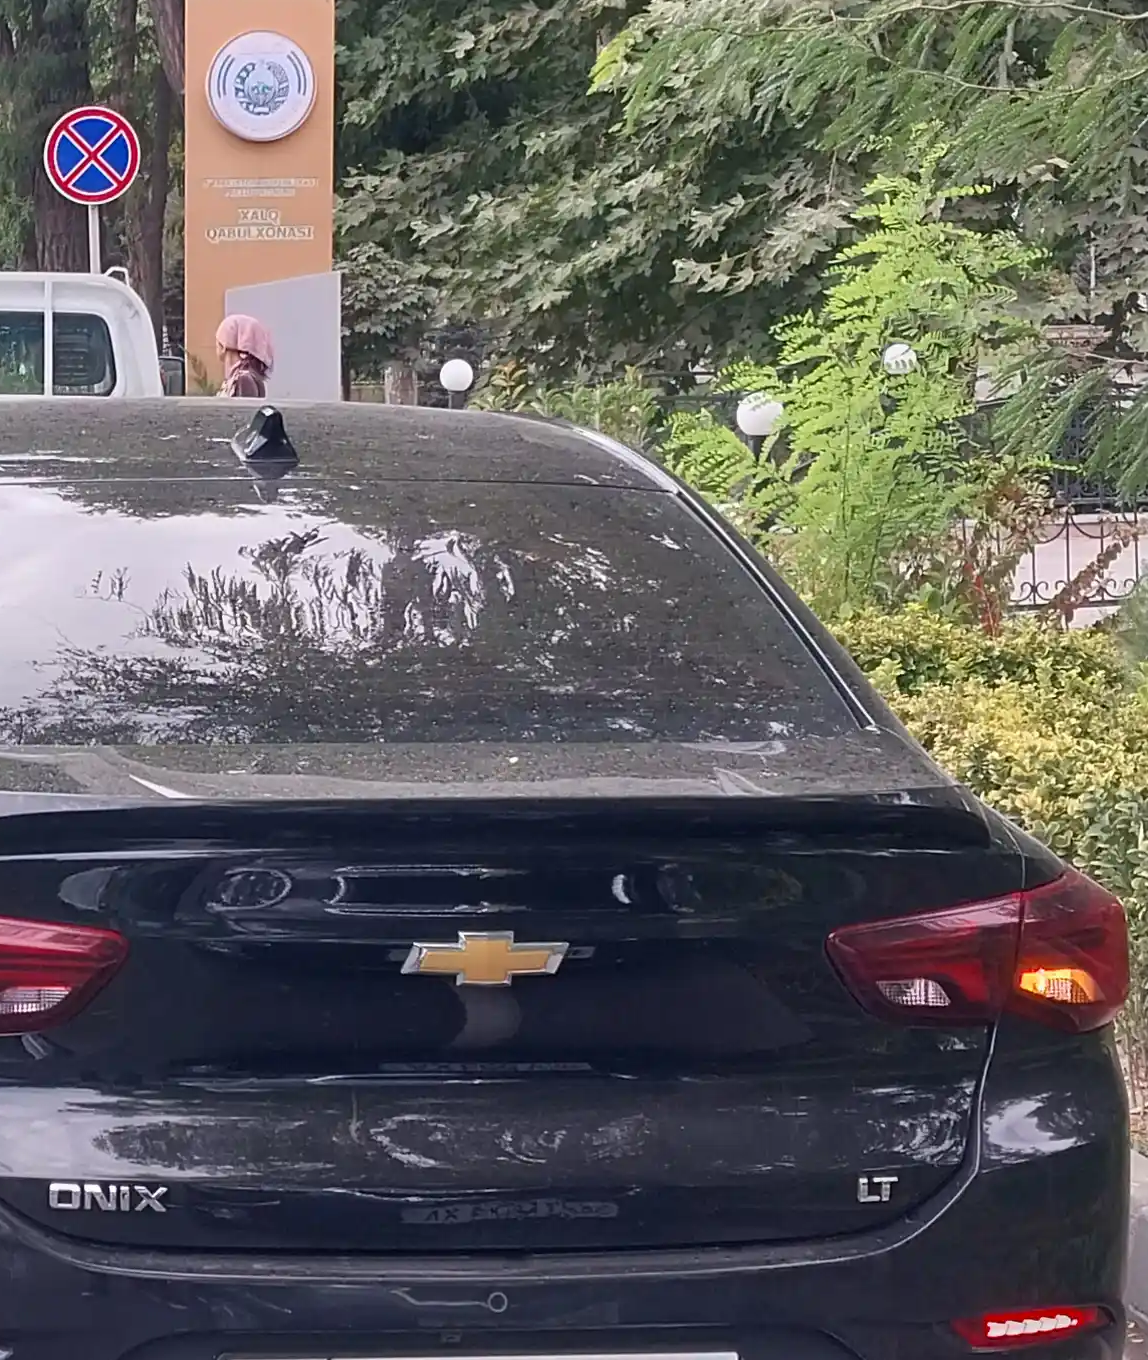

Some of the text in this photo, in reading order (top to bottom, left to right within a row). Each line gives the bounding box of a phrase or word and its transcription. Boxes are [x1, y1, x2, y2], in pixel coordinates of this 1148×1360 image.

[238, 208, 280, 225] XALQ
[255, 225, 313, 240] XONASI
[49, 1182, 168, 1212] ONIX
[857, 1176, 899, 1202] LT
